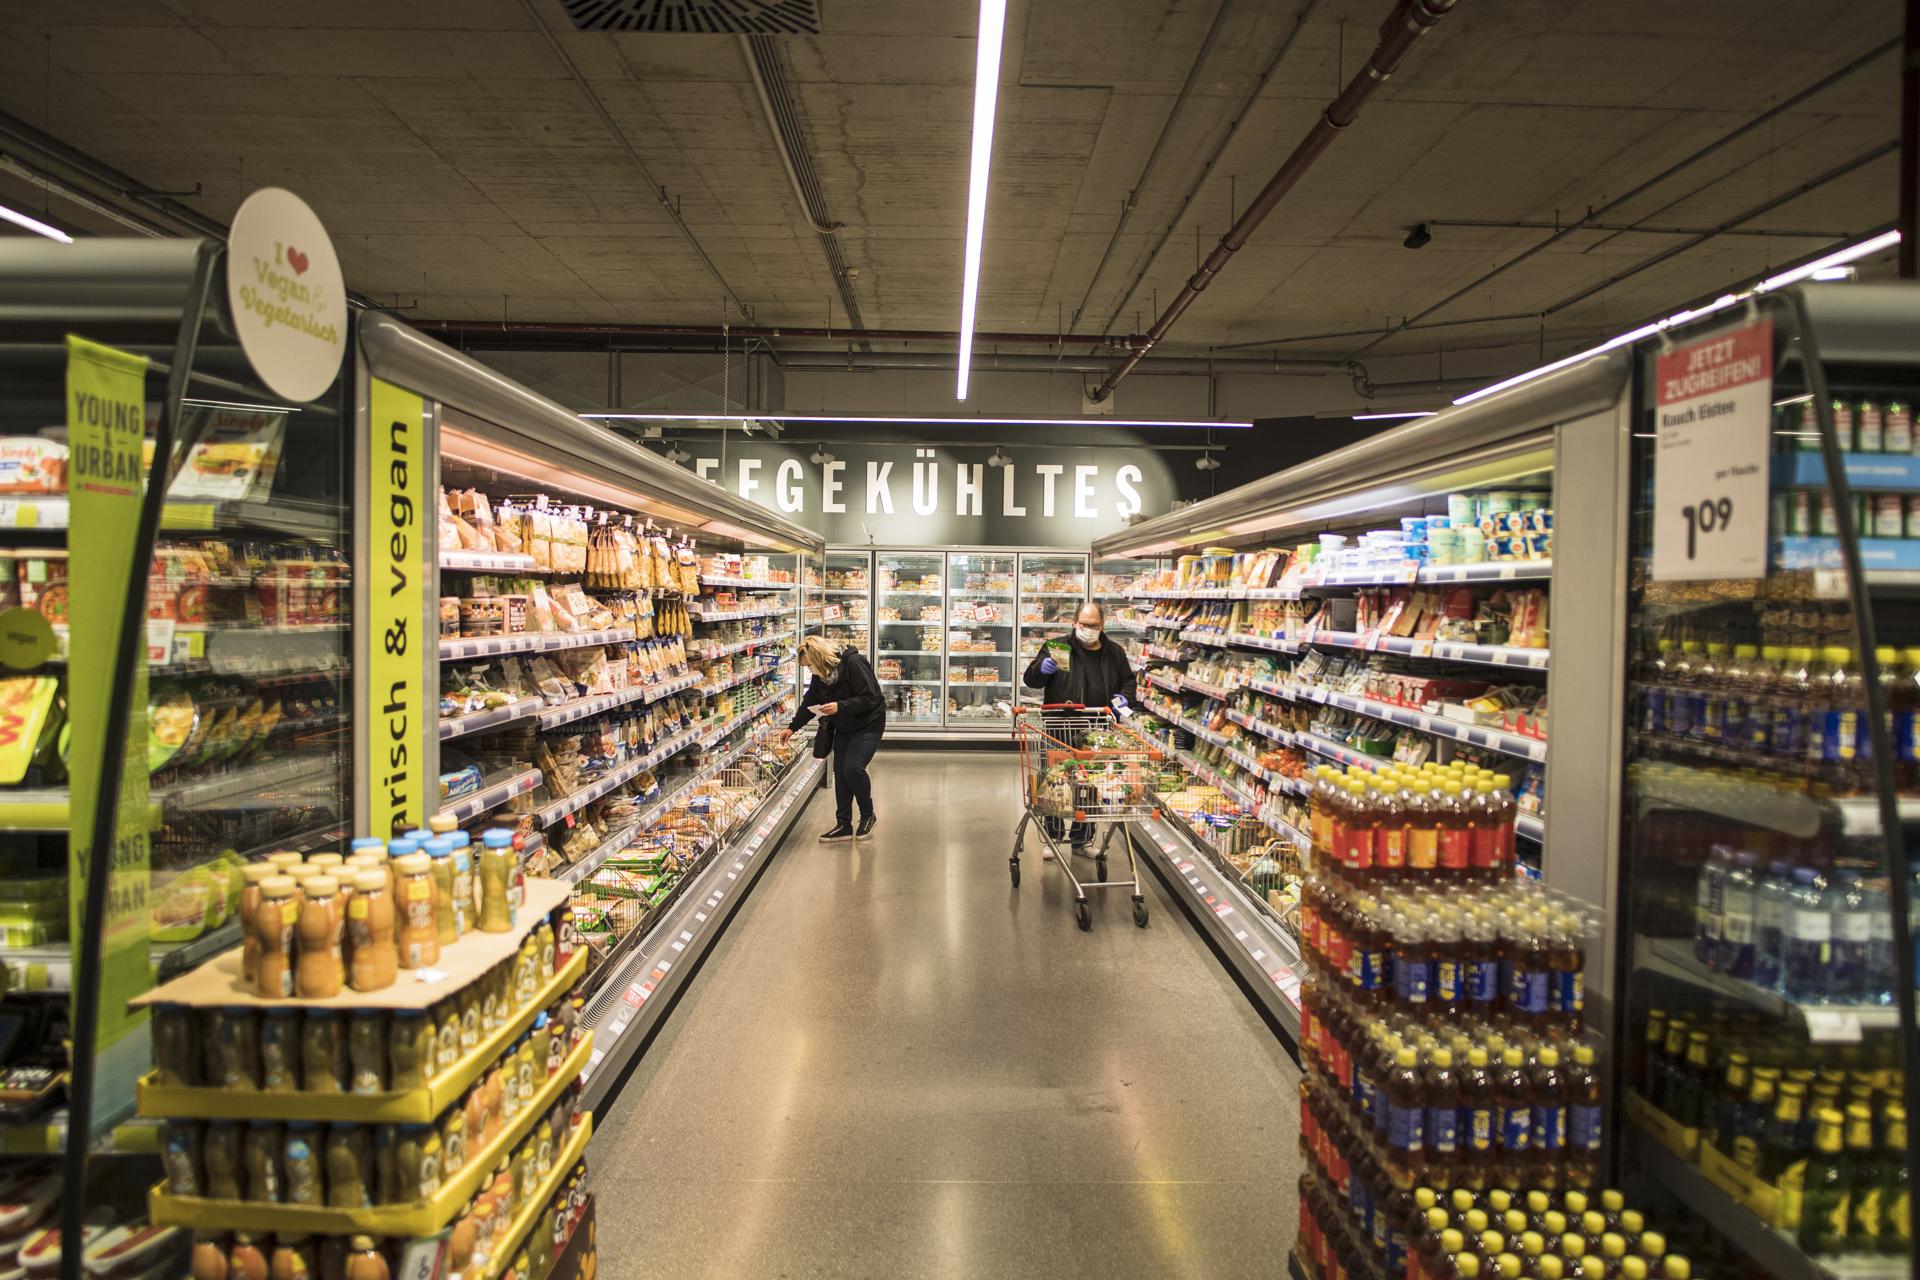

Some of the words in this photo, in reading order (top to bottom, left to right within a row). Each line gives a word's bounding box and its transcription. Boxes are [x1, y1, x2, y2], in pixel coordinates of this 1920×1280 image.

[253, 256, 310, 304] Vegan
[239, 285, 337, 345] Vegetarisch
[1687, 338, 1736, 372] JETZT
[75, 391, 140, 435] YOUNG
[1663, 408, 1697, 428] Rauch
[1699, 400, 1736, 421] Eistee
[75, 445, 140, 482] URBAN
[389, 420, 413, 598] vegan
[384, 616, 408, 656] &
